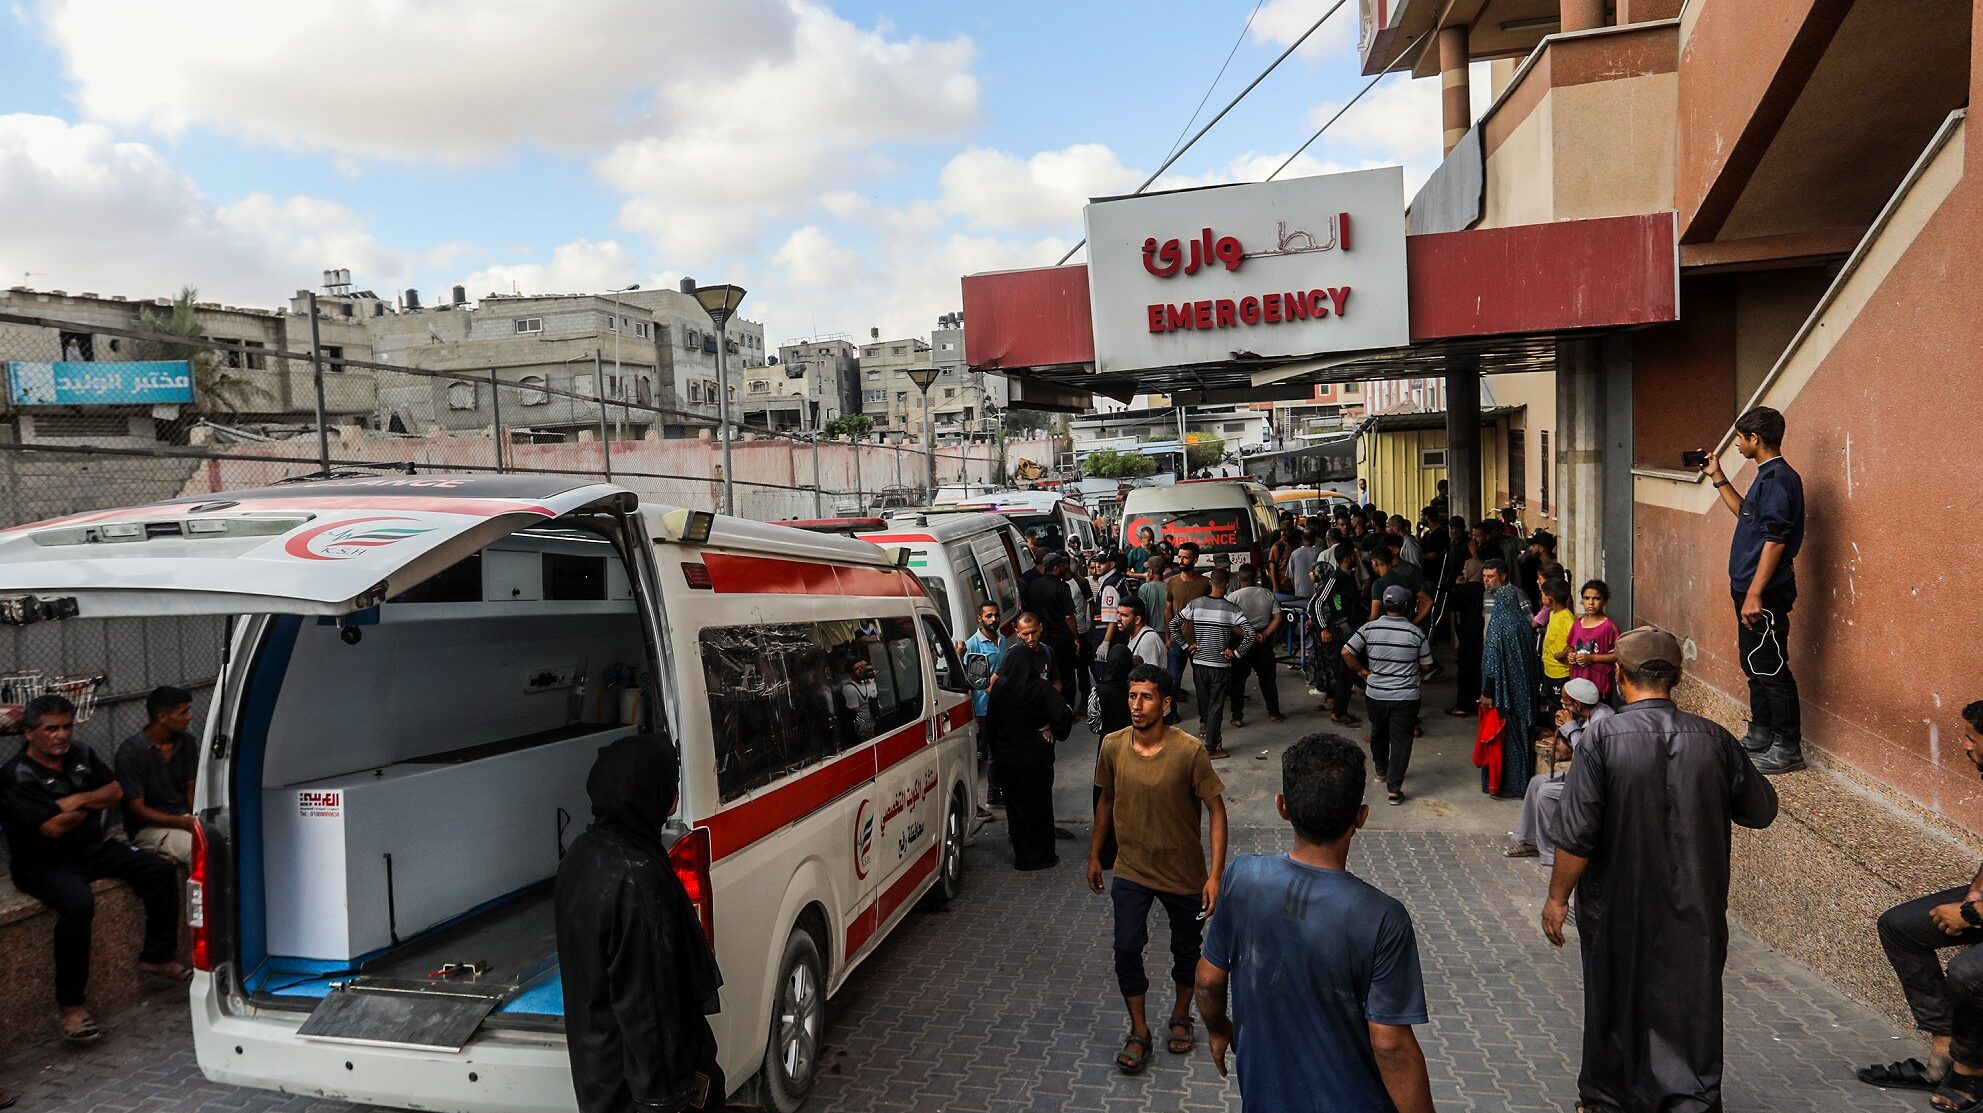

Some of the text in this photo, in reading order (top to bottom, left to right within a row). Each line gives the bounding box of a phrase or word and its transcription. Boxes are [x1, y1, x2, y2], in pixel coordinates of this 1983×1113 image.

[1141, 212, 1351, 278] الطوارئ
[1147, 286, 1352, 334] EMERGENCY
[56, 371, 190, 395] مختبر الوليد
